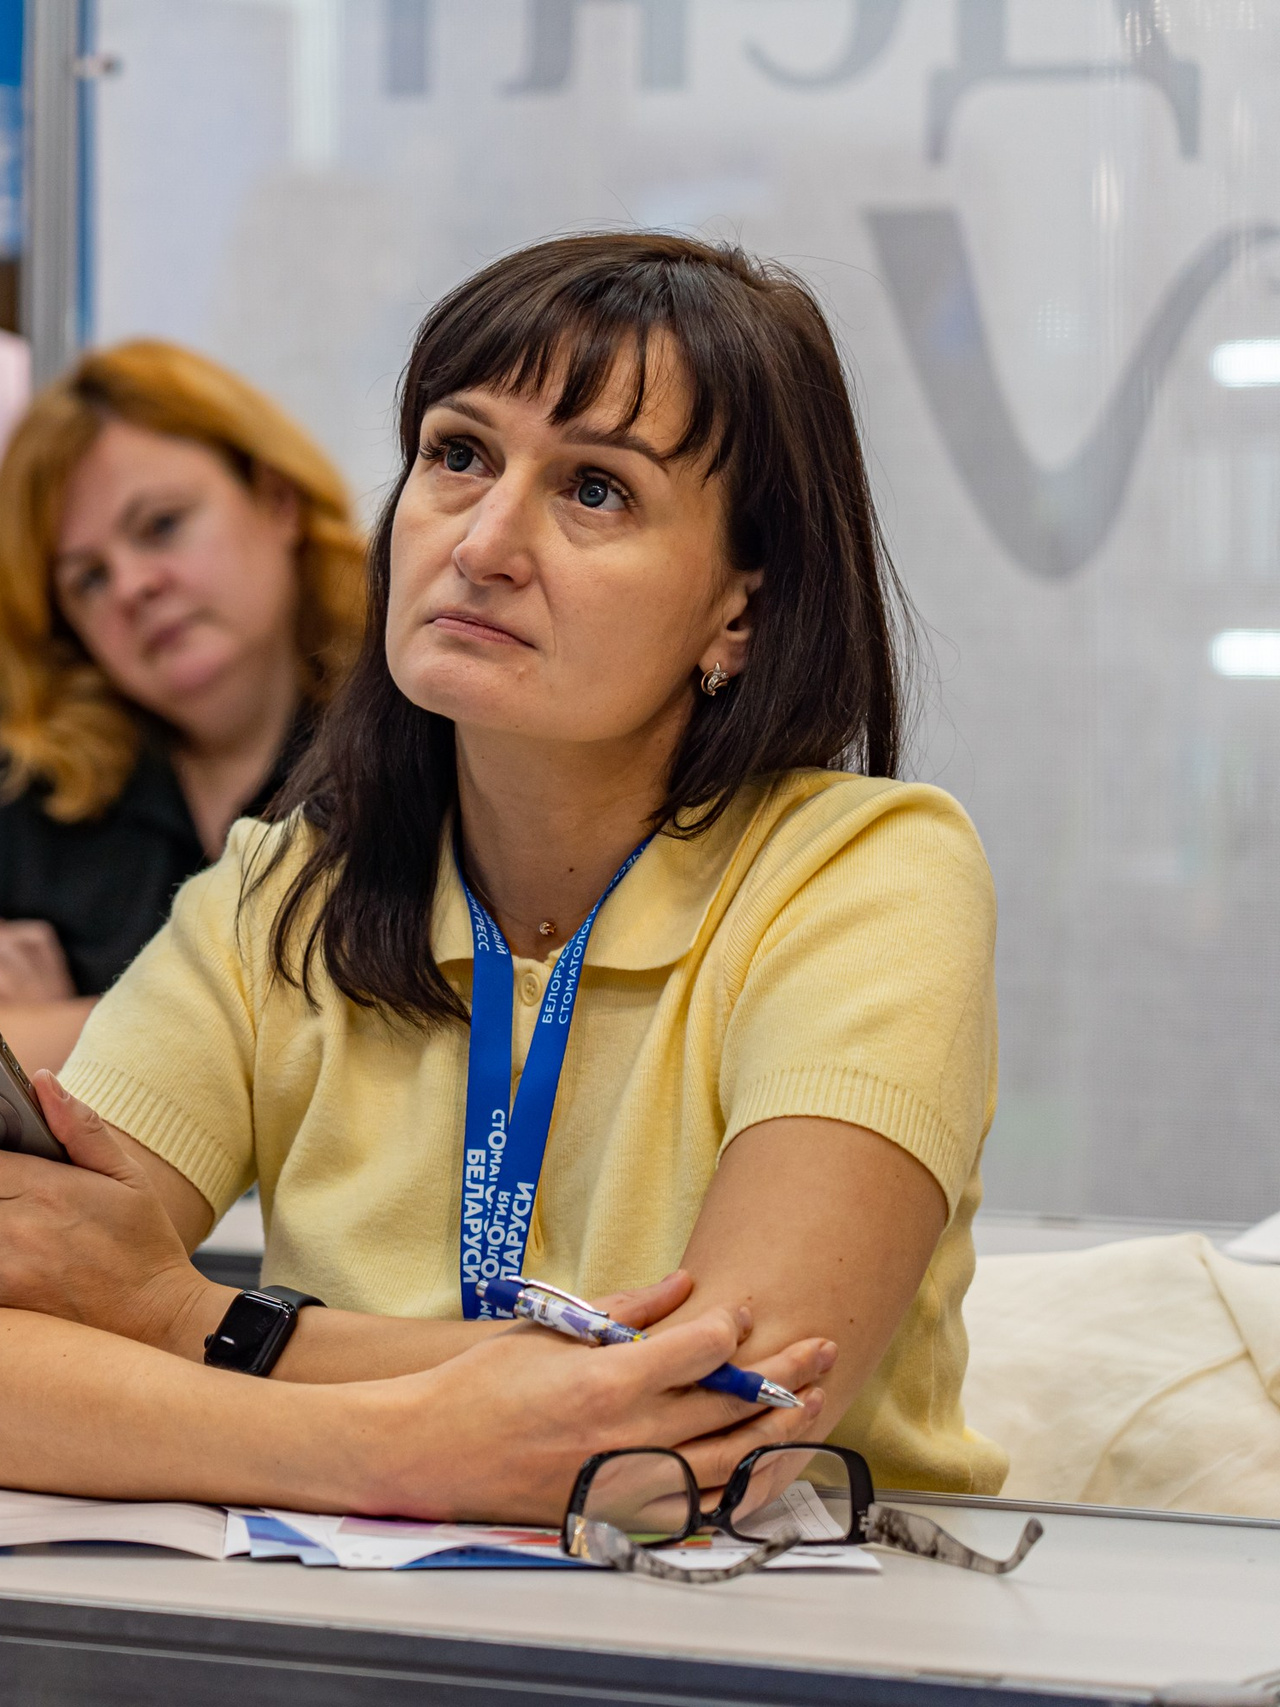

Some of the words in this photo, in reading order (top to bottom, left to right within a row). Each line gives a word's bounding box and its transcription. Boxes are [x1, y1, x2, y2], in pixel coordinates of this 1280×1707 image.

[542, 932, 576, 1024] БЕЛОРУСС
[558, 902, 600, 1025] СТОМАТОЛОГИ
[463, 1149, 486, 1283] БЕЛАРУСИ
